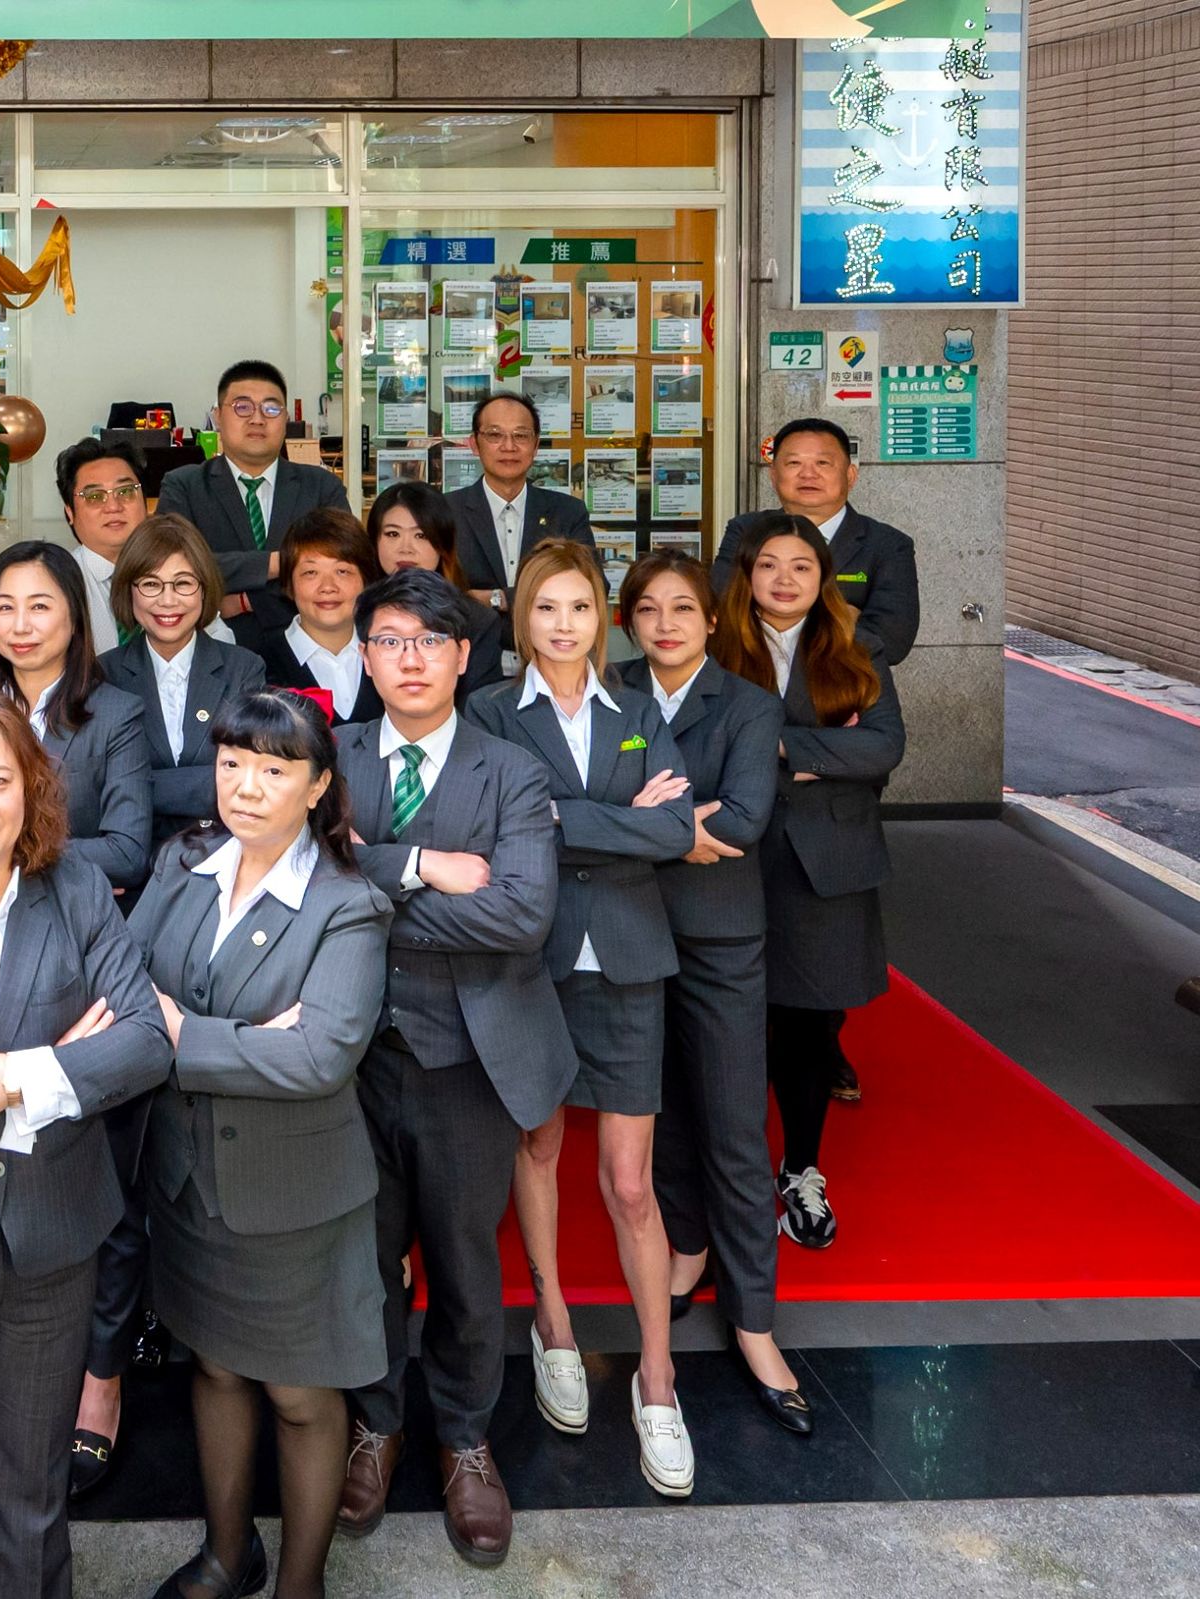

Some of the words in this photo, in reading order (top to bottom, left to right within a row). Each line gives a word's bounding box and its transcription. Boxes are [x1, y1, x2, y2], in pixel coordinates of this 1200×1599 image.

[938, 6, 994, 297] 艇有限公司
[828, 37, 904, 298] 健之星
[407, 242, 467, 261] 精選
[551, 242, 610, 261] 推薦
[782, 348, 812, 366] 42
[831, 371, 873, 382] 防空避難
